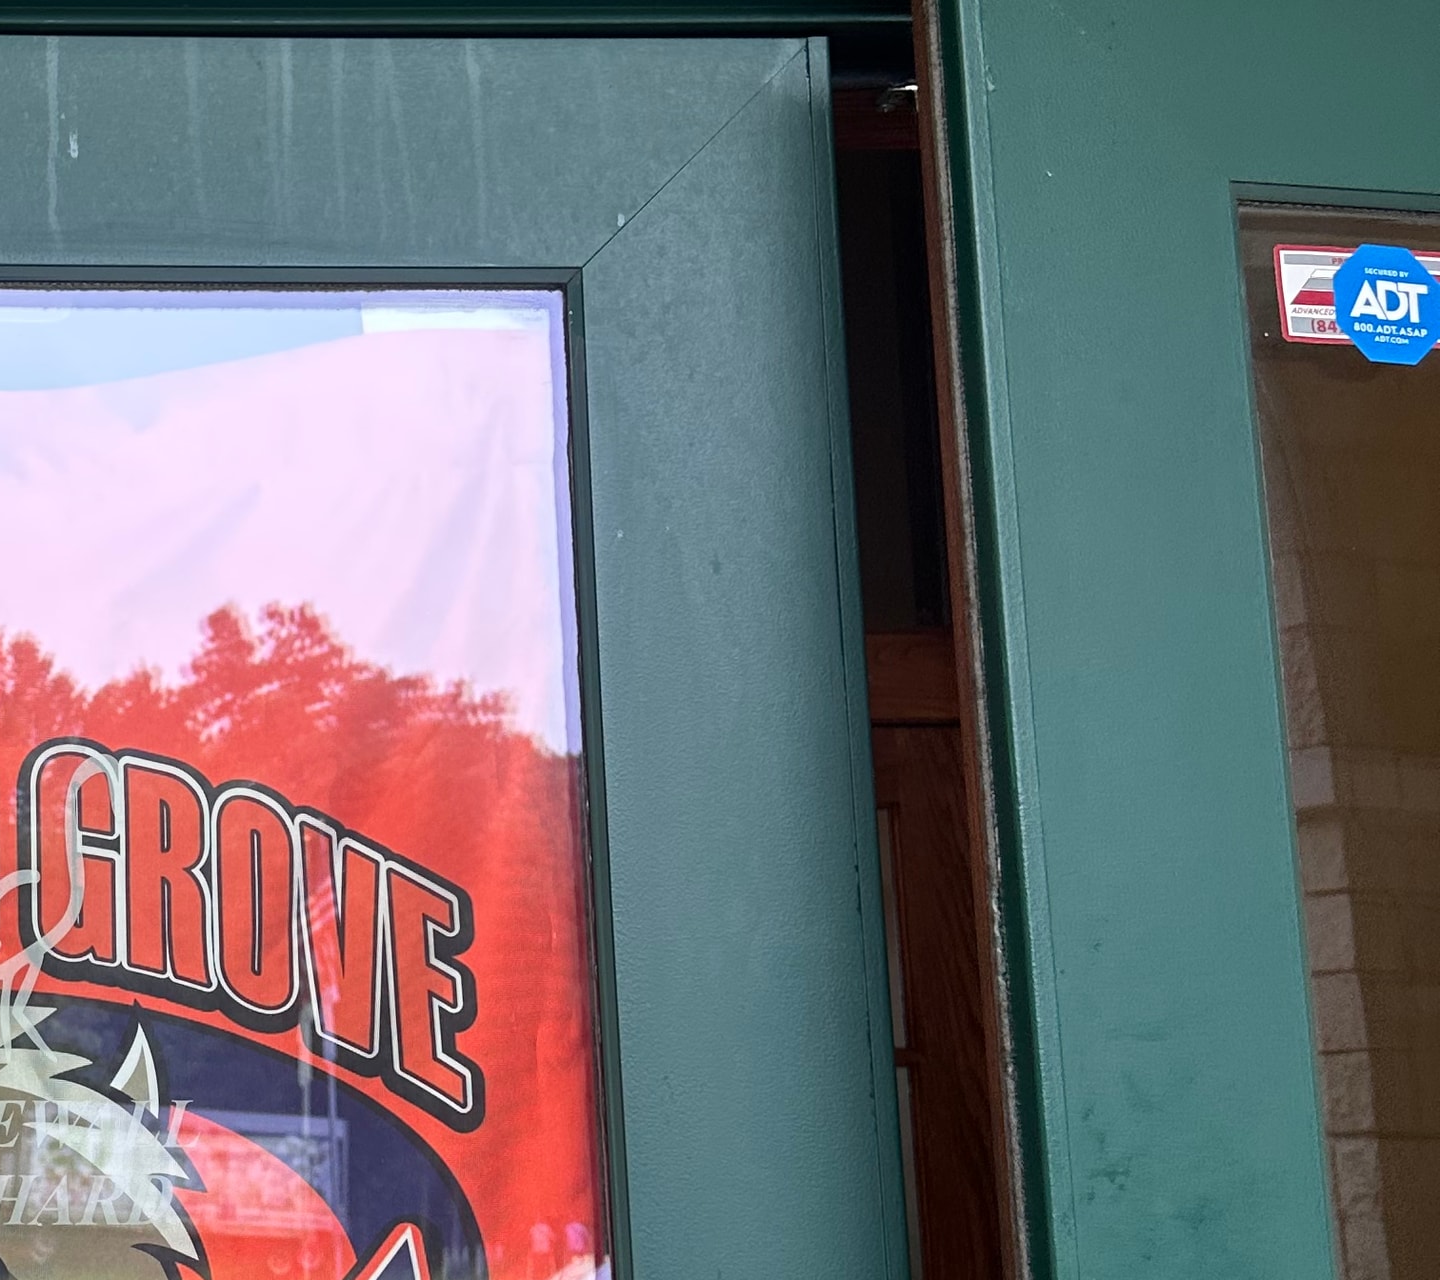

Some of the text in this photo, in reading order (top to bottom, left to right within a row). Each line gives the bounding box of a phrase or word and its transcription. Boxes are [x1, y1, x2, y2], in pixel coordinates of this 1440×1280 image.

[1364, 267, 1398, 277] SECURED
[1350, 279, 1428, 323] ADT
[1291, 307, 1335, 316] ADVANCED
[1311, 318, 1345, 334] (84
[1353, 322, 1427, 337] 800.ADT.ASAP
[23, 739, 480, 1124] GROVE
